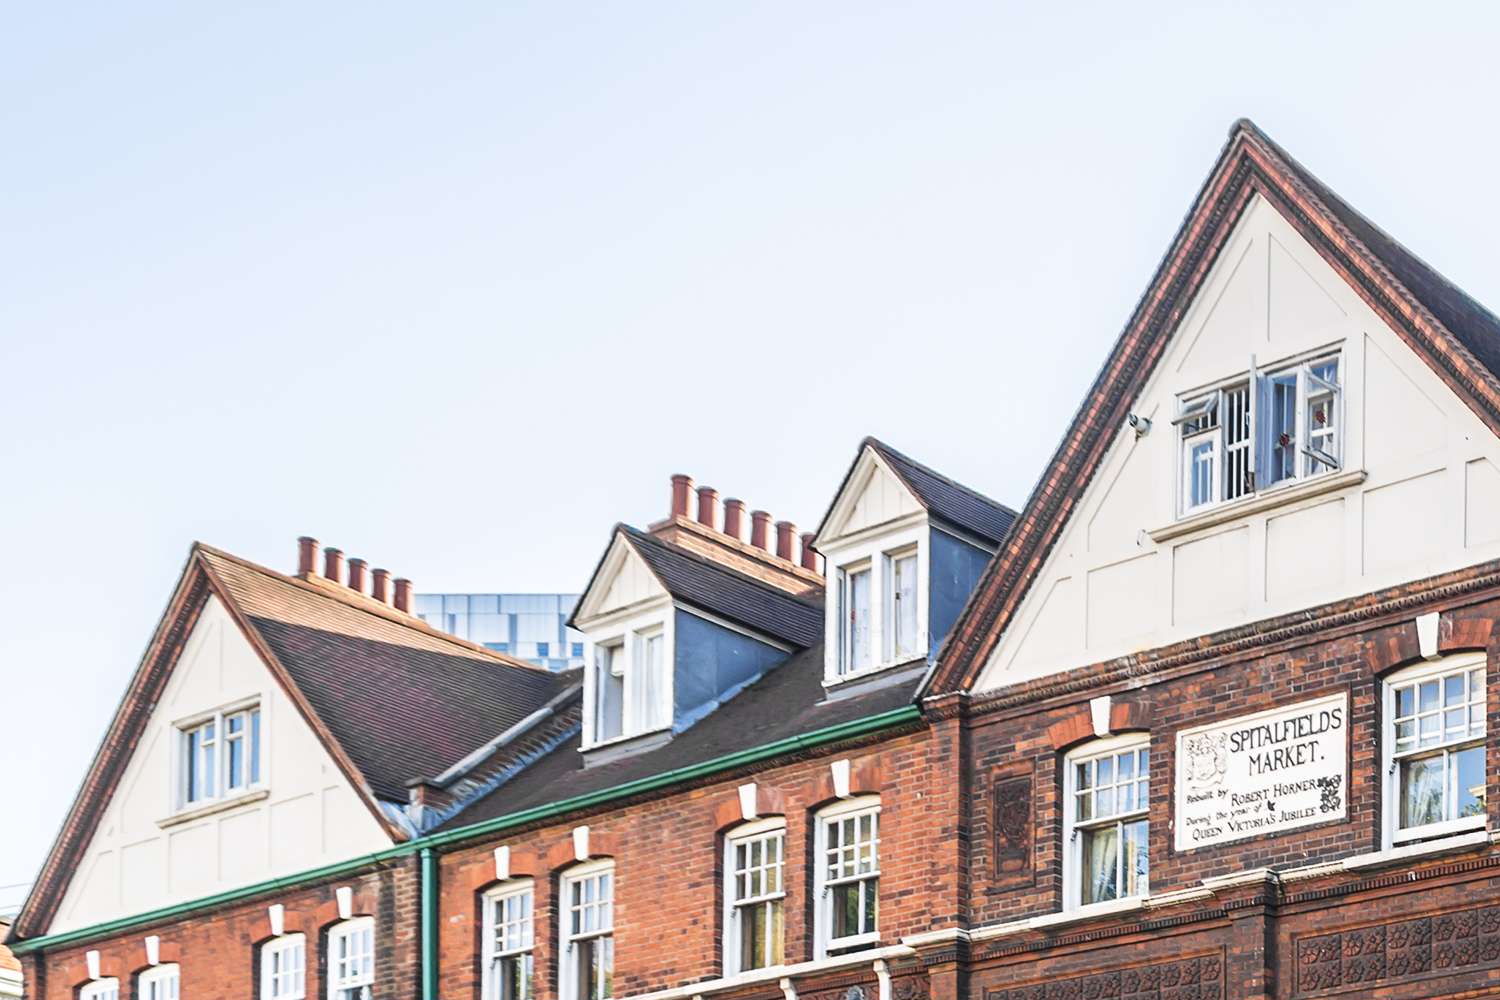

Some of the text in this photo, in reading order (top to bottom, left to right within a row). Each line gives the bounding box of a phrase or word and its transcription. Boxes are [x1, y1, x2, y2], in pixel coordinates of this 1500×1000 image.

[1230, 708, 1342, 753] SPITALFIELDS
[1217, 788, 1229, 800] by
[1231, 778, 1316, 806] ROBERT HORNER
[1192, 826, 1223, 842] QUEEN
[1278, 807, 1317, 823] JUBILEE
